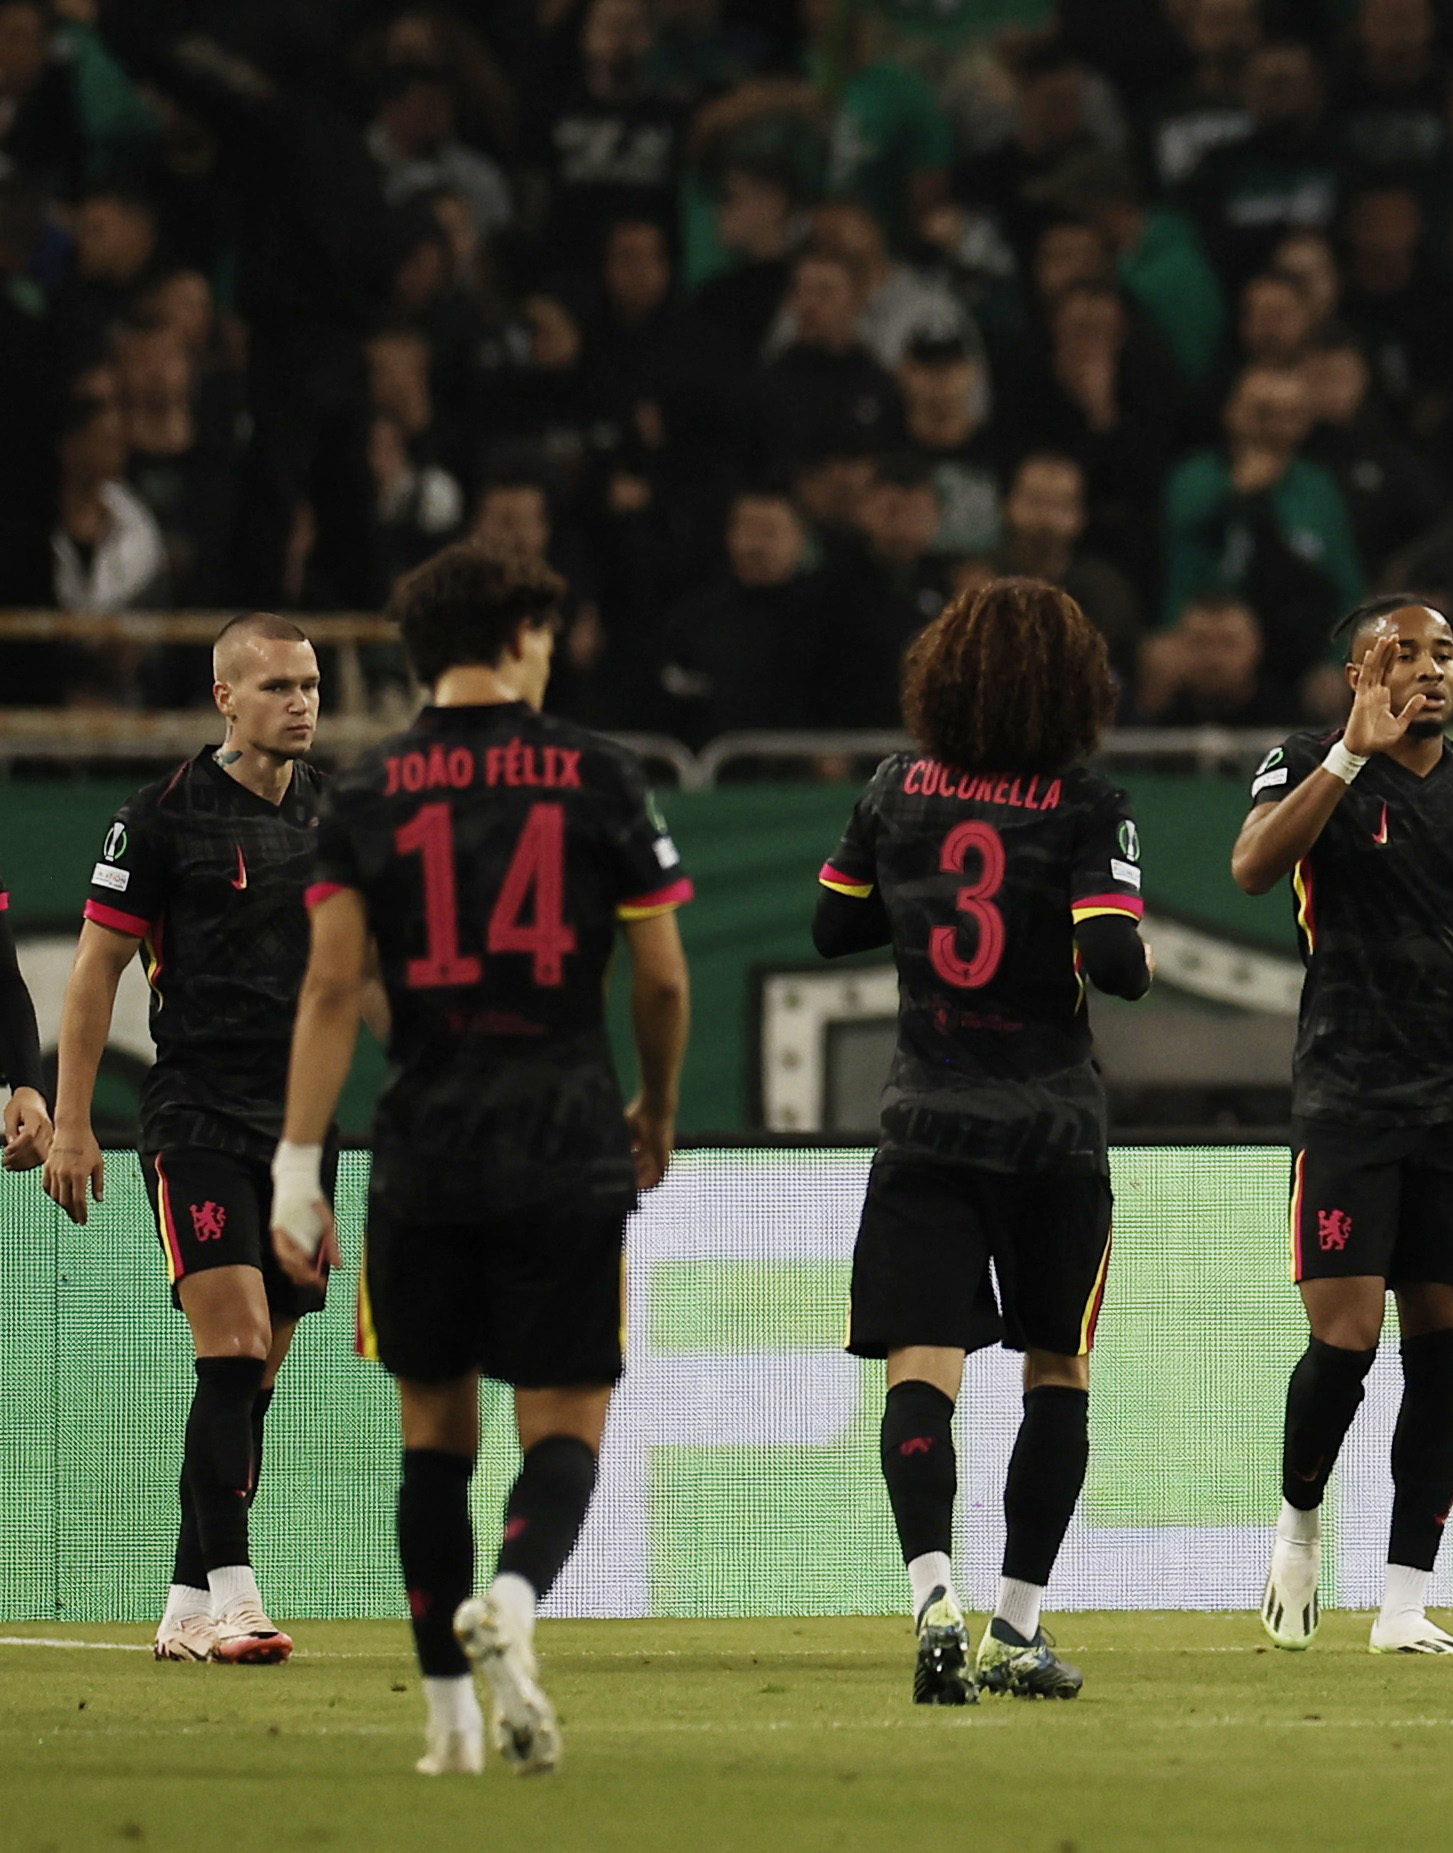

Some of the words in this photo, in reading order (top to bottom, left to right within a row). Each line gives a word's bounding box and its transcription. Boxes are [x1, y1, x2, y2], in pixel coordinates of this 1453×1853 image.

[385, 744, 474, 796] JOÃO
[486, 736, 581, 788] FÉLIX
[394, 802, 578, 987] 14
[929, 820, 1006, 989] 3
